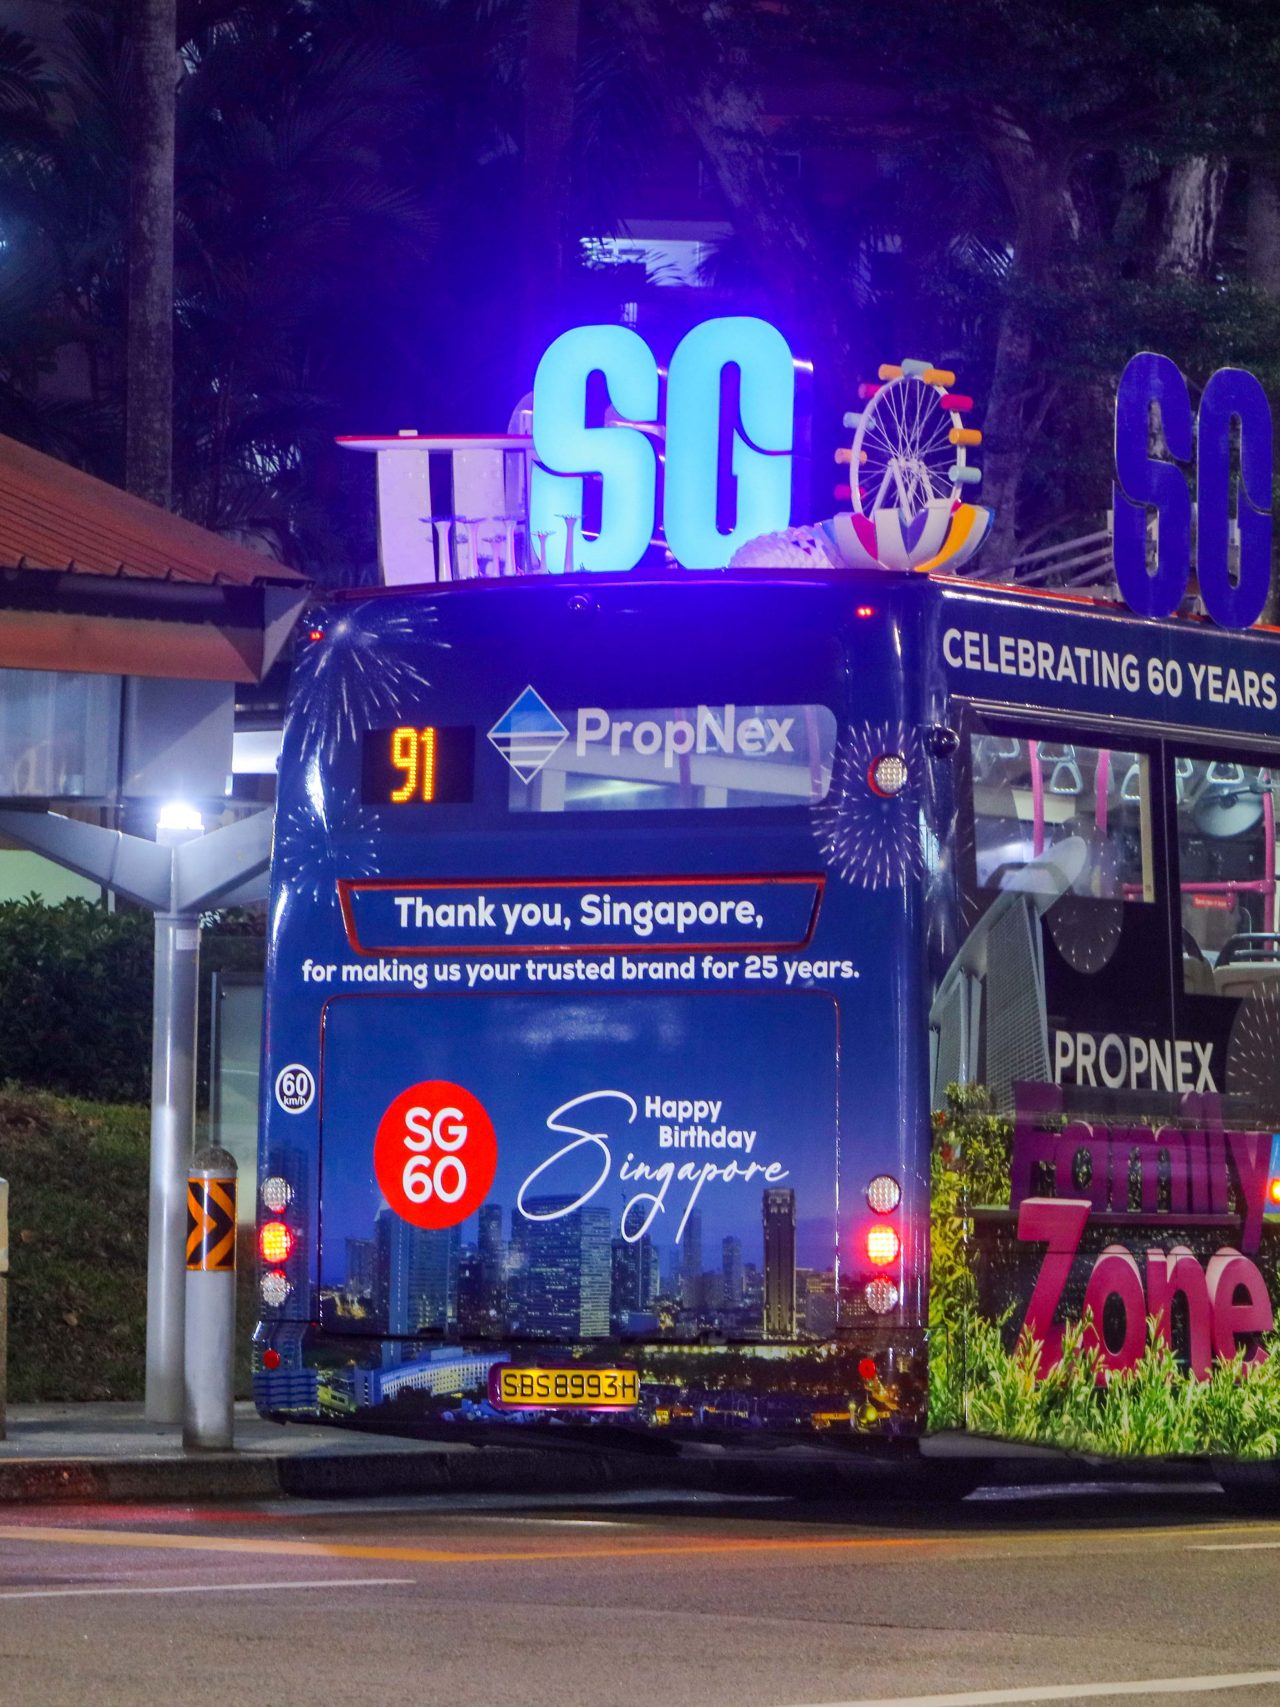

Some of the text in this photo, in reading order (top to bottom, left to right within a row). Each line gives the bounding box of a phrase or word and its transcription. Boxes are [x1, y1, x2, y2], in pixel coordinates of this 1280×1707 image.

[530, 316, 794, 573] SG
[942, 628, 1140, 693] CELEBRATING
[1147, 657, 1183, 699] 60
[1187, 662, 1277, 711] YEARS
[575, 703, 797, 769] PropNex
[391, 727, 436, 803] 91
[394, 893, 765, 935] Thank you, Singapore,
[302, 955, 860, 989] for making us your trusted brand for 25 years.
[283, 1072, 308, 1096] 60
[1054, 1029, 1219, 1094] PROPNEX
[283, 1096, 306, 1105] km/h
[645, 1096, 722, 1125] Happy
[403, 1106, 468, 1153] SG
[659, 1125, 757, 1152] Birthday
[402, 1156, 468, 1203] 60
[517, 1089, 790, 1244] Singapore
[1011, 1081, 1273, 1255] Family
[1013, 1196, 1274, 1387] Zone
[504, 1374, 636, 1398] SBS8993H
